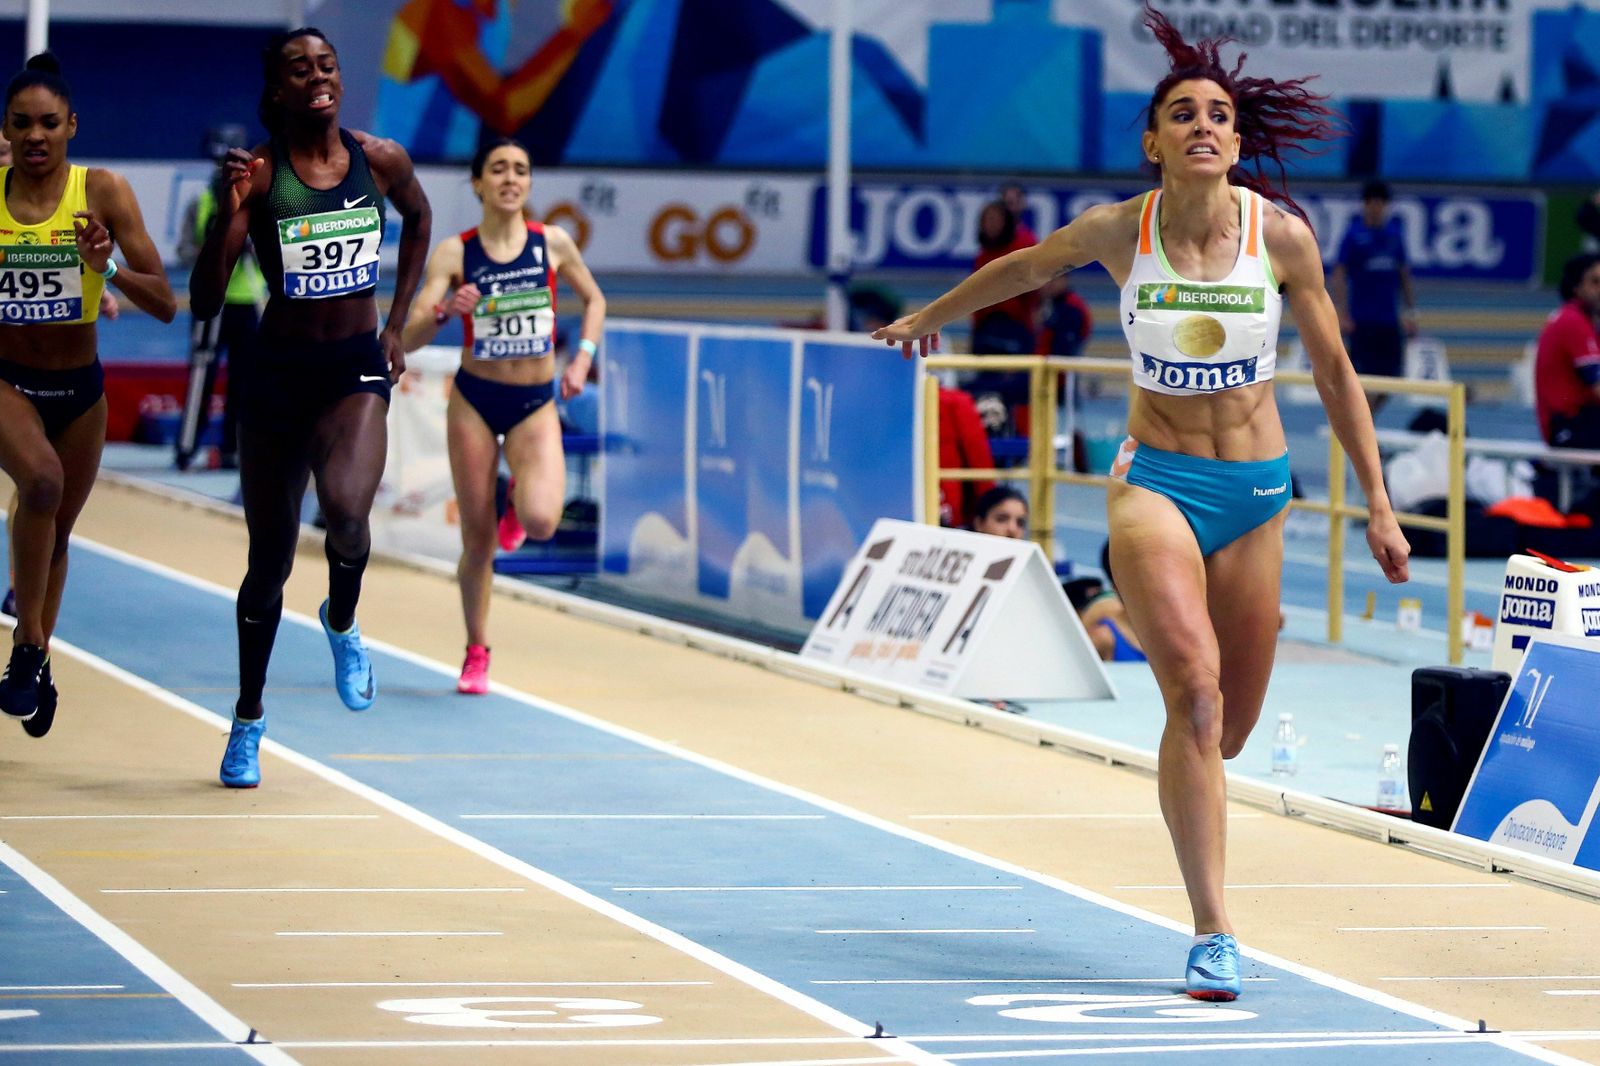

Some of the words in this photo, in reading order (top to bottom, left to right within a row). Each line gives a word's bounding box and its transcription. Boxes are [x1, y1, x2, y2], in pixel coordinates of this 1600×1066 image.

[1347, 13, 1508, 53] DEPORTE
[312, 217, 375, 234] IBERDROLA
[647, 205, 756, 263] GO
[7, 253, 73, 263] IBERDROLA
[302, 238, 365, 270] 397
[0, 271, 63, 299] 495
[294, 266, 370, 296] Joma
[1178, 291, 1254, 305] IBERDROLA
[487, 315, 536, 337] 301
[1149, 359, 1246, 390] Joma
[1504, 575, 1559, 593] MONDO
